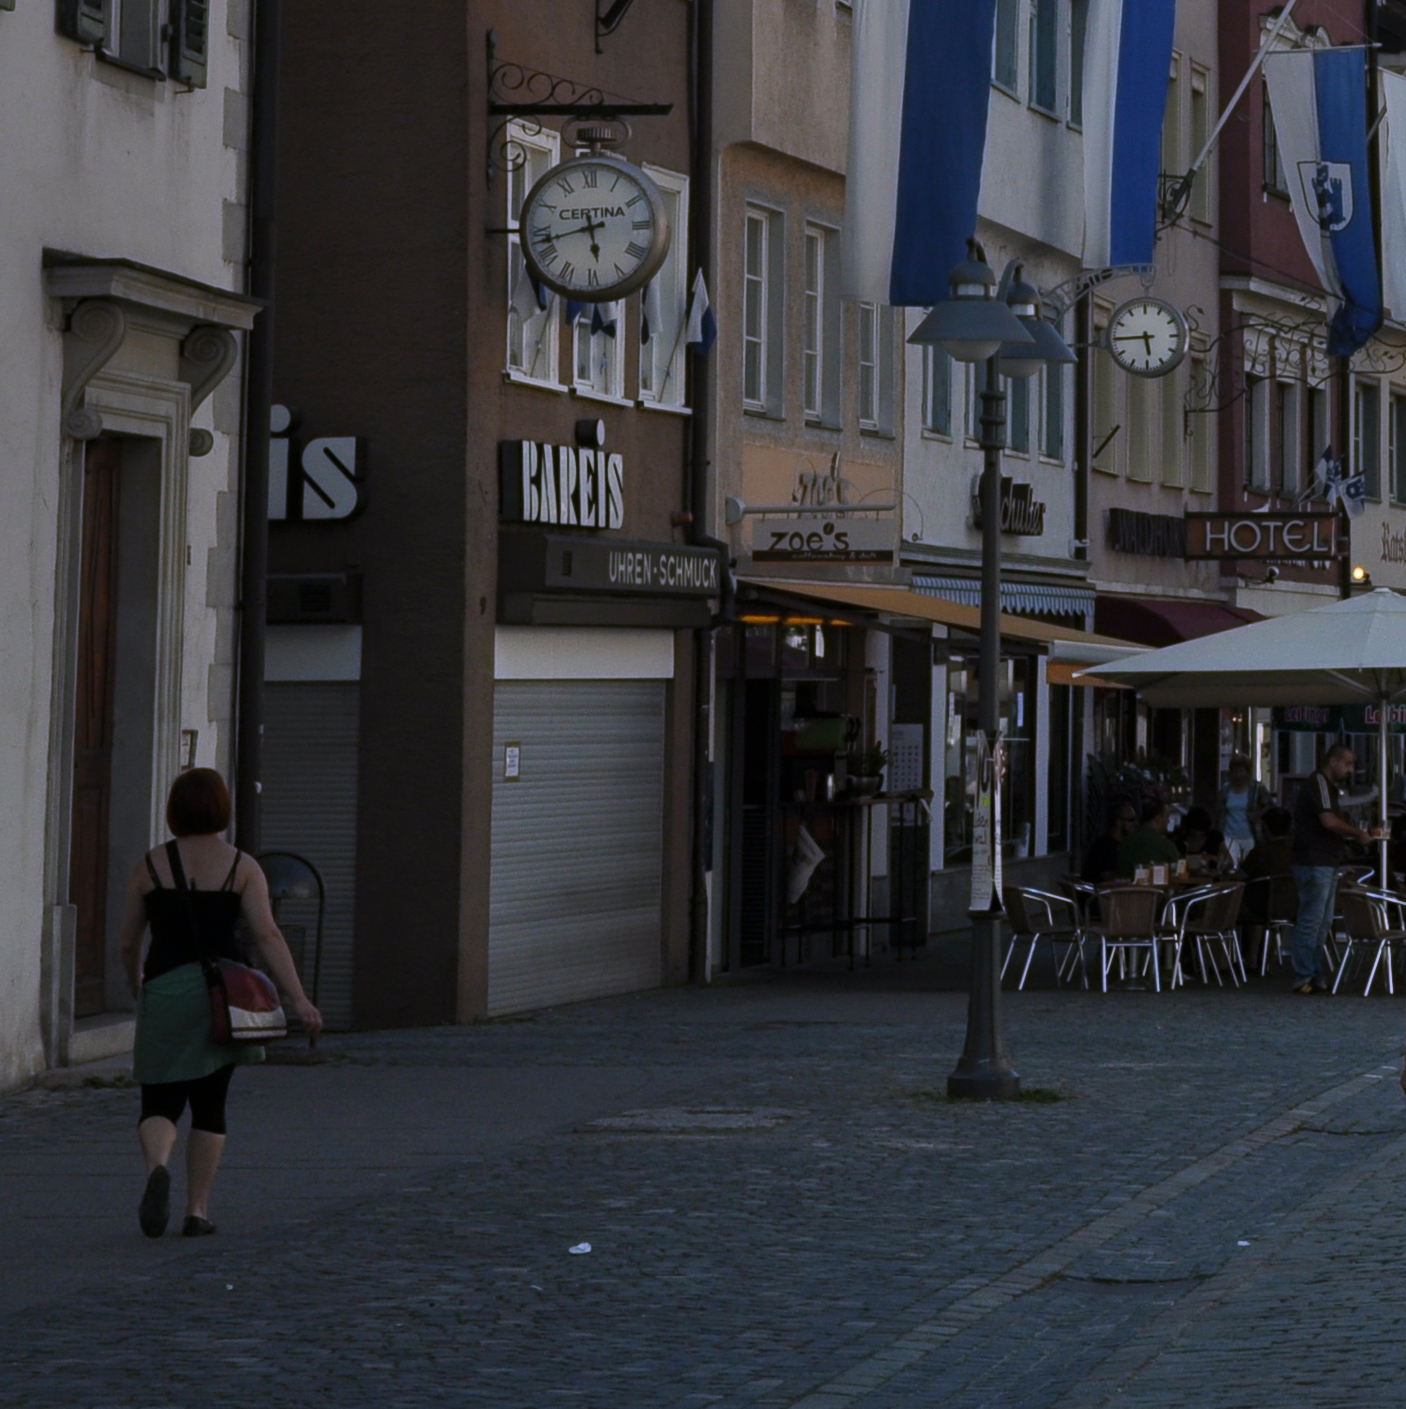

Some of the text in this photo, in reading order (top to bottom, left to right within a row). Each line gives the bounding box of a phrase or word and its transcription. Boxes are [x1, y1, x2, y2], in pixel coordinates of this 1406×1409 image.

[559, 206, 626, 222] CERTINA
[1205, 519, 1329, 554] HOTEL
[609, 551, 717, 588] UHREN SCHMUCK
